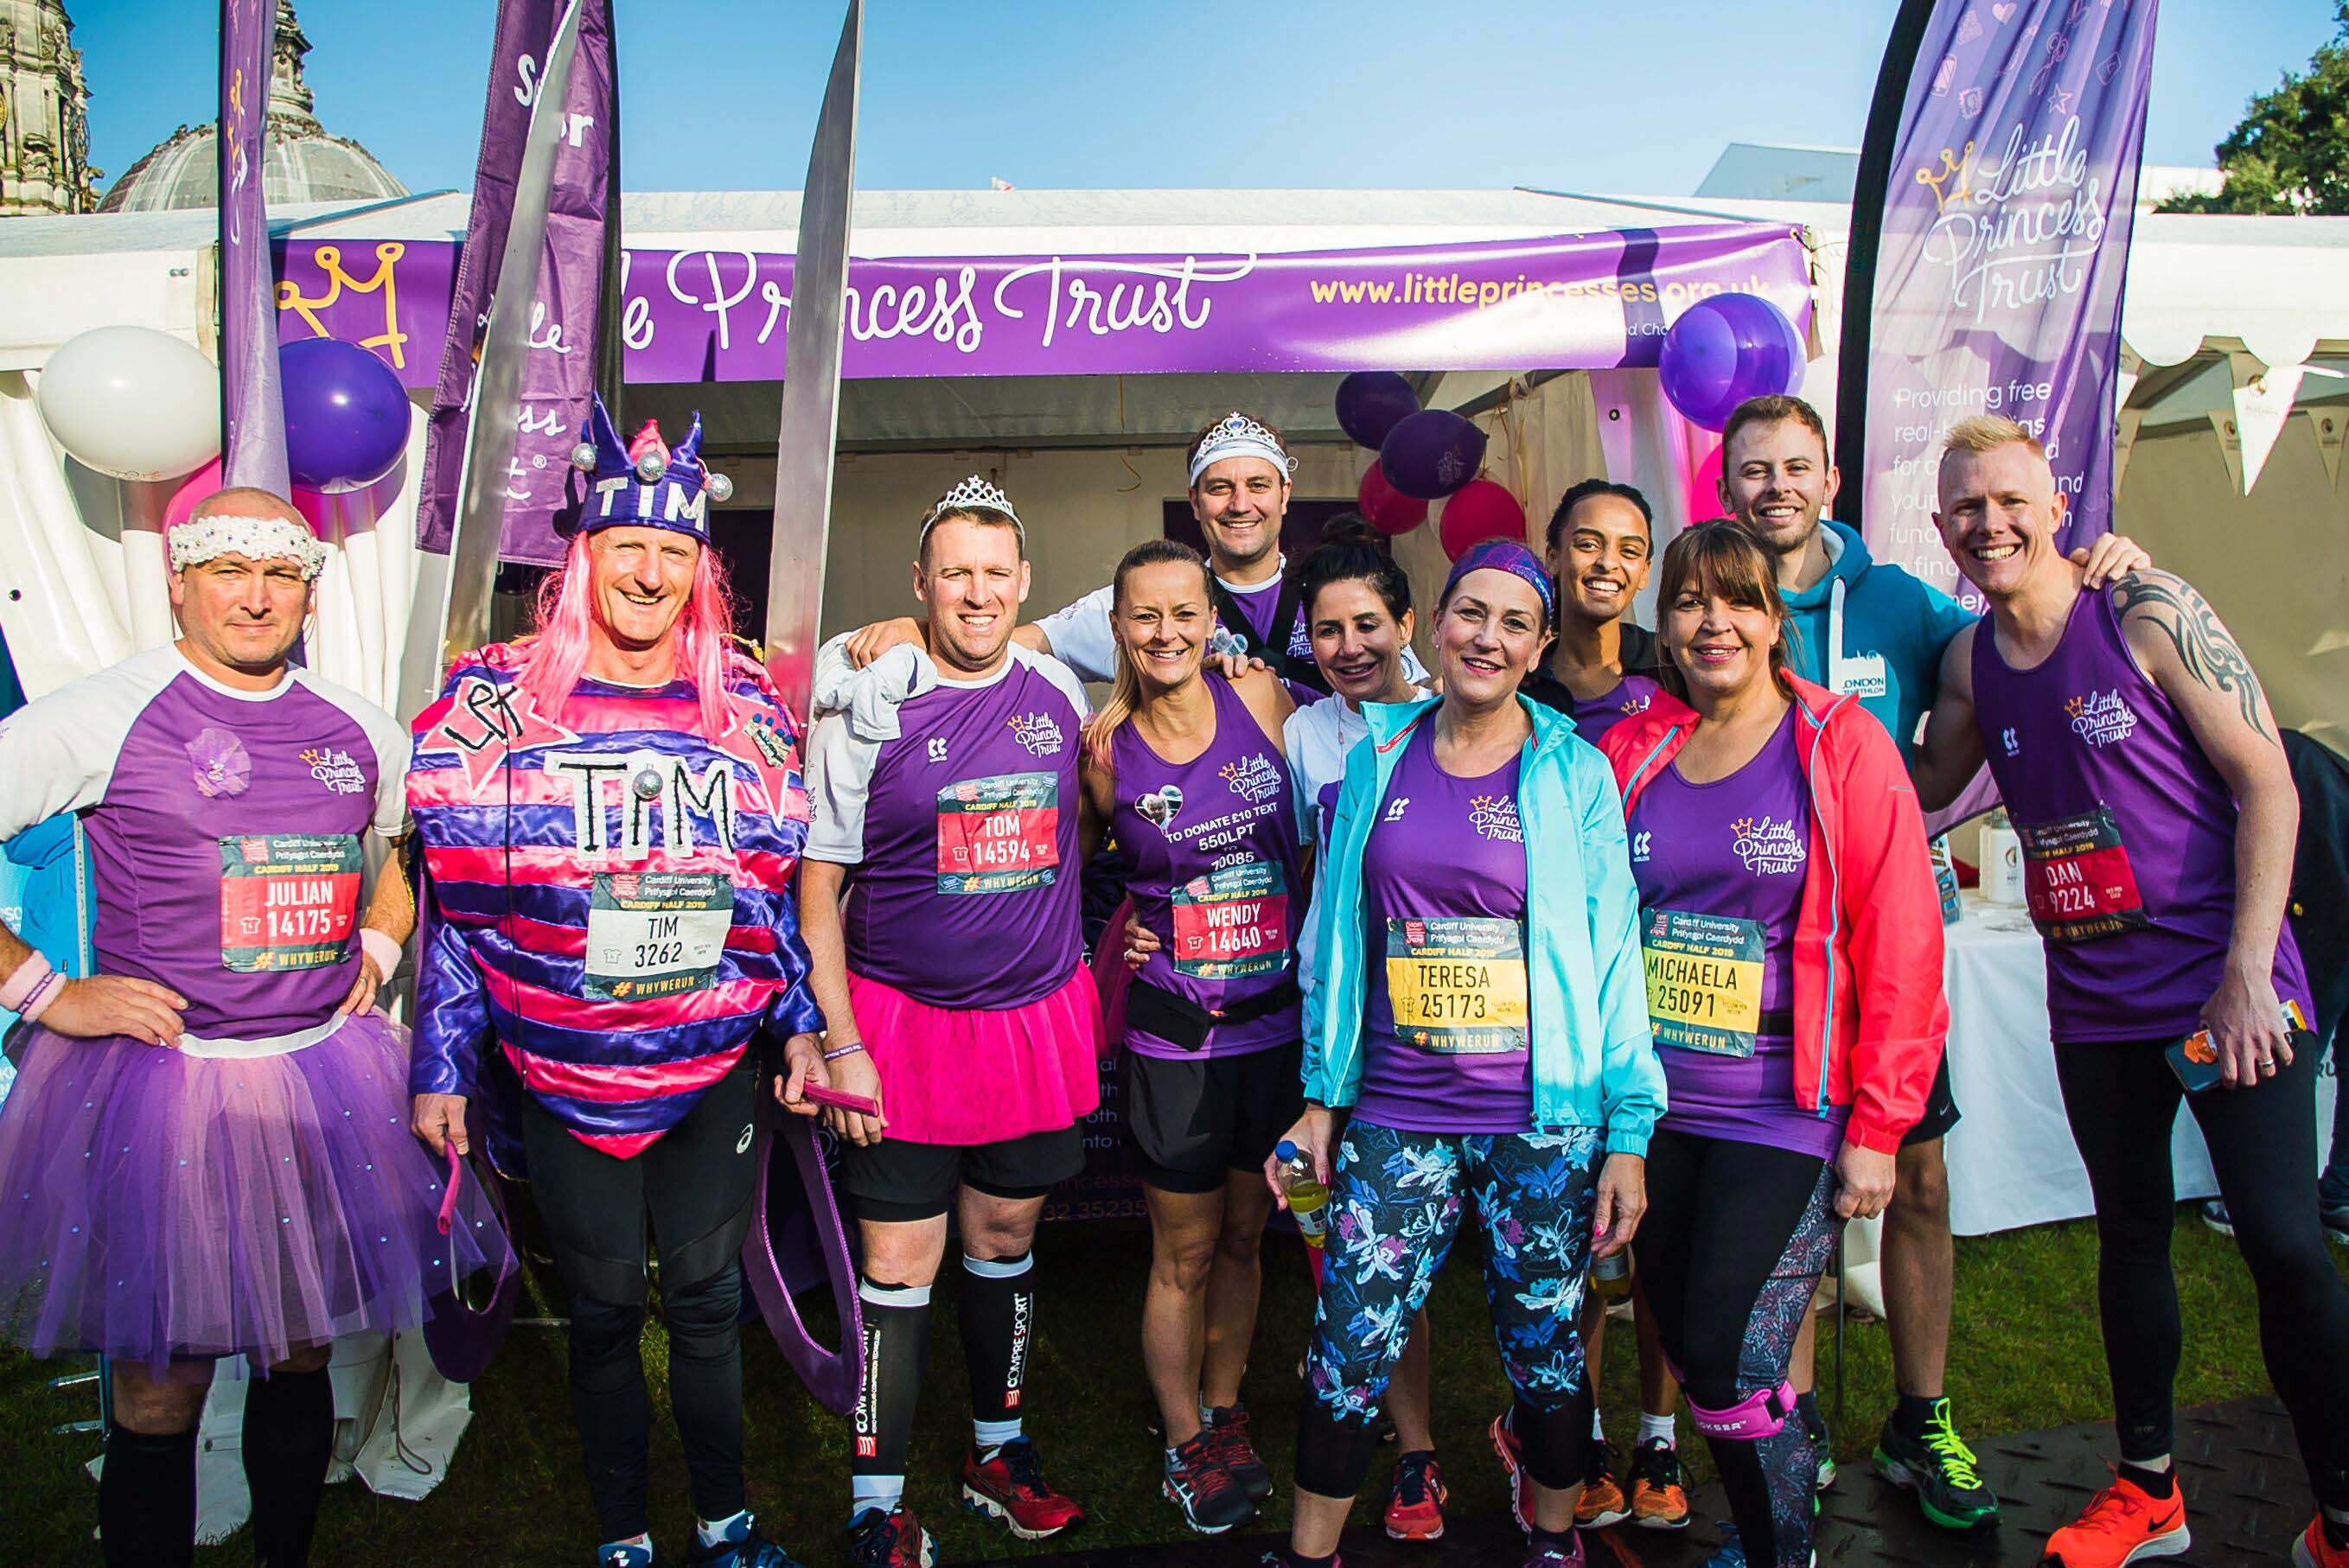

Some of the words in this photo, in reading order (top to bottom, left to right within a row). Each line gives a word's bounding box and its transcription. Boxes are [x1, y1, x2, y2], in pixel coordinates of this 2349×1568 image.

[1975, 114, 2088, 205] Little
[1922, 177, 2106, 290] Princess
[1954, 239, 2101, 325] Trust
[667, 248, 983, 352] Prncess
[994, 252, 1256, 347] Trust
[1896, 379, 2003, 410] Providing
[2008, 379, 2052, 403] free
[596, 476, 707, 532] TIM
[2083, 688, 2123, 715] Little
[1024, 711, 1054, 730] Little
[2071, 709, 2138, 741] Princess
[1029, 740, 1063, 758] Trust
[2086, 723, 2137, 749] Trust
[321, 747, 356, 768] Little
[1237, 752, 1272, 777] Little
[1229, 764, 1281, 797] Princess
[1245, 780, 1280, 805] Trust
[984, 815, 1020, 838] TOM
[1166, 832, 1183, 844] TO
[1184, 815, 1230, 838] DONATE
[1231, 809, 1253, 823] £10
[1253, 802, 1278, 817] TEXT
[1751, 816, 1796, 842] Little
[1198, 822, 1256, 851] 550LPT
[973, 838, 1031, 865] 14594
[1210, 851, 1254, 871] 70085
[1733, 837, 1807, 864] Princess
[1746, 856, 1804, 877] Trust
[2046, 861, 2084, 887] DAN
[265, 881, 334, 907] JULIAN
[645, 876, 673, 885] Cardiff
[674, 876, 712, 887] University
[620, 901, 660, 909] CARDIFF
[2049, 885, 2096, 914] 9224
[266, 908, 331, 938] 14175
[648, 916, 679, 940] TIM
[1206, 902, 1261, 928] WENDY
[1430, 921, 1458, 931] Cardiff
[1701, 920, 1739, 934] University
[1208, 926, 1262, 953] 14640
[1652, 939, 1686, 950] CARDIFF
[1687, 943, 1710, 953] HALF
[1712, 947, 1734, 957] 2019
[635, 941, 683, 968] 3262
[1418, 965, 1490, 989] TERESA
[1647, 955, 1738, 991] MICHAELA
[1420, 993, 1486, 1018] 25173
[1657, 985, 1714, 1017] 25091
